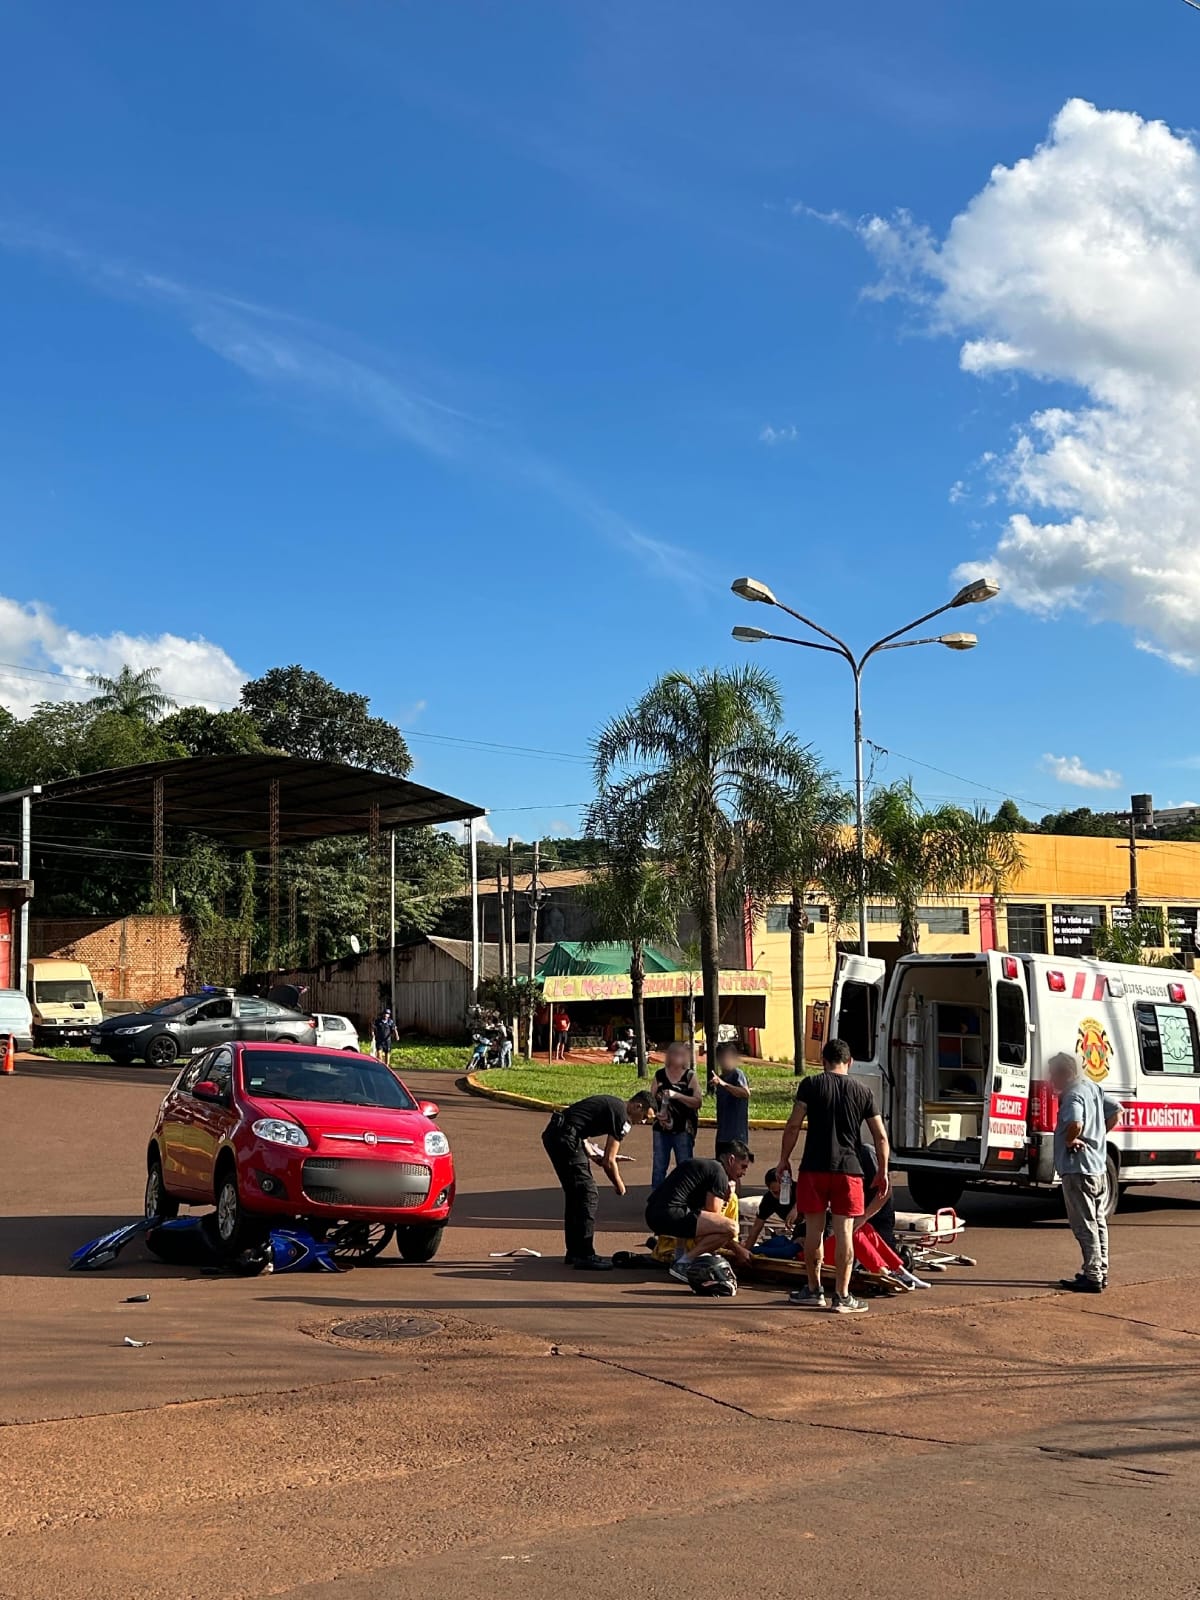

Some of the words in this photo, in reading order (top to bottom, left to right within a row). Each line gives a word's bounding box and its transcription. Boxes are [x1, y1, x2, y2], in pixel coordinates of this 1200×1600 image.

[554, 978, 575, 997] La
[581, 977, 628, 1000] Negra
[996, 1098, 1022, 1116] RESCATE
[1137, 1108, 1144, 1126] Y
[1146, 1104, 1194, 1127] LOGÍSTICA
[989, 1121, 1025, 1137] VOLUNTARIOS
